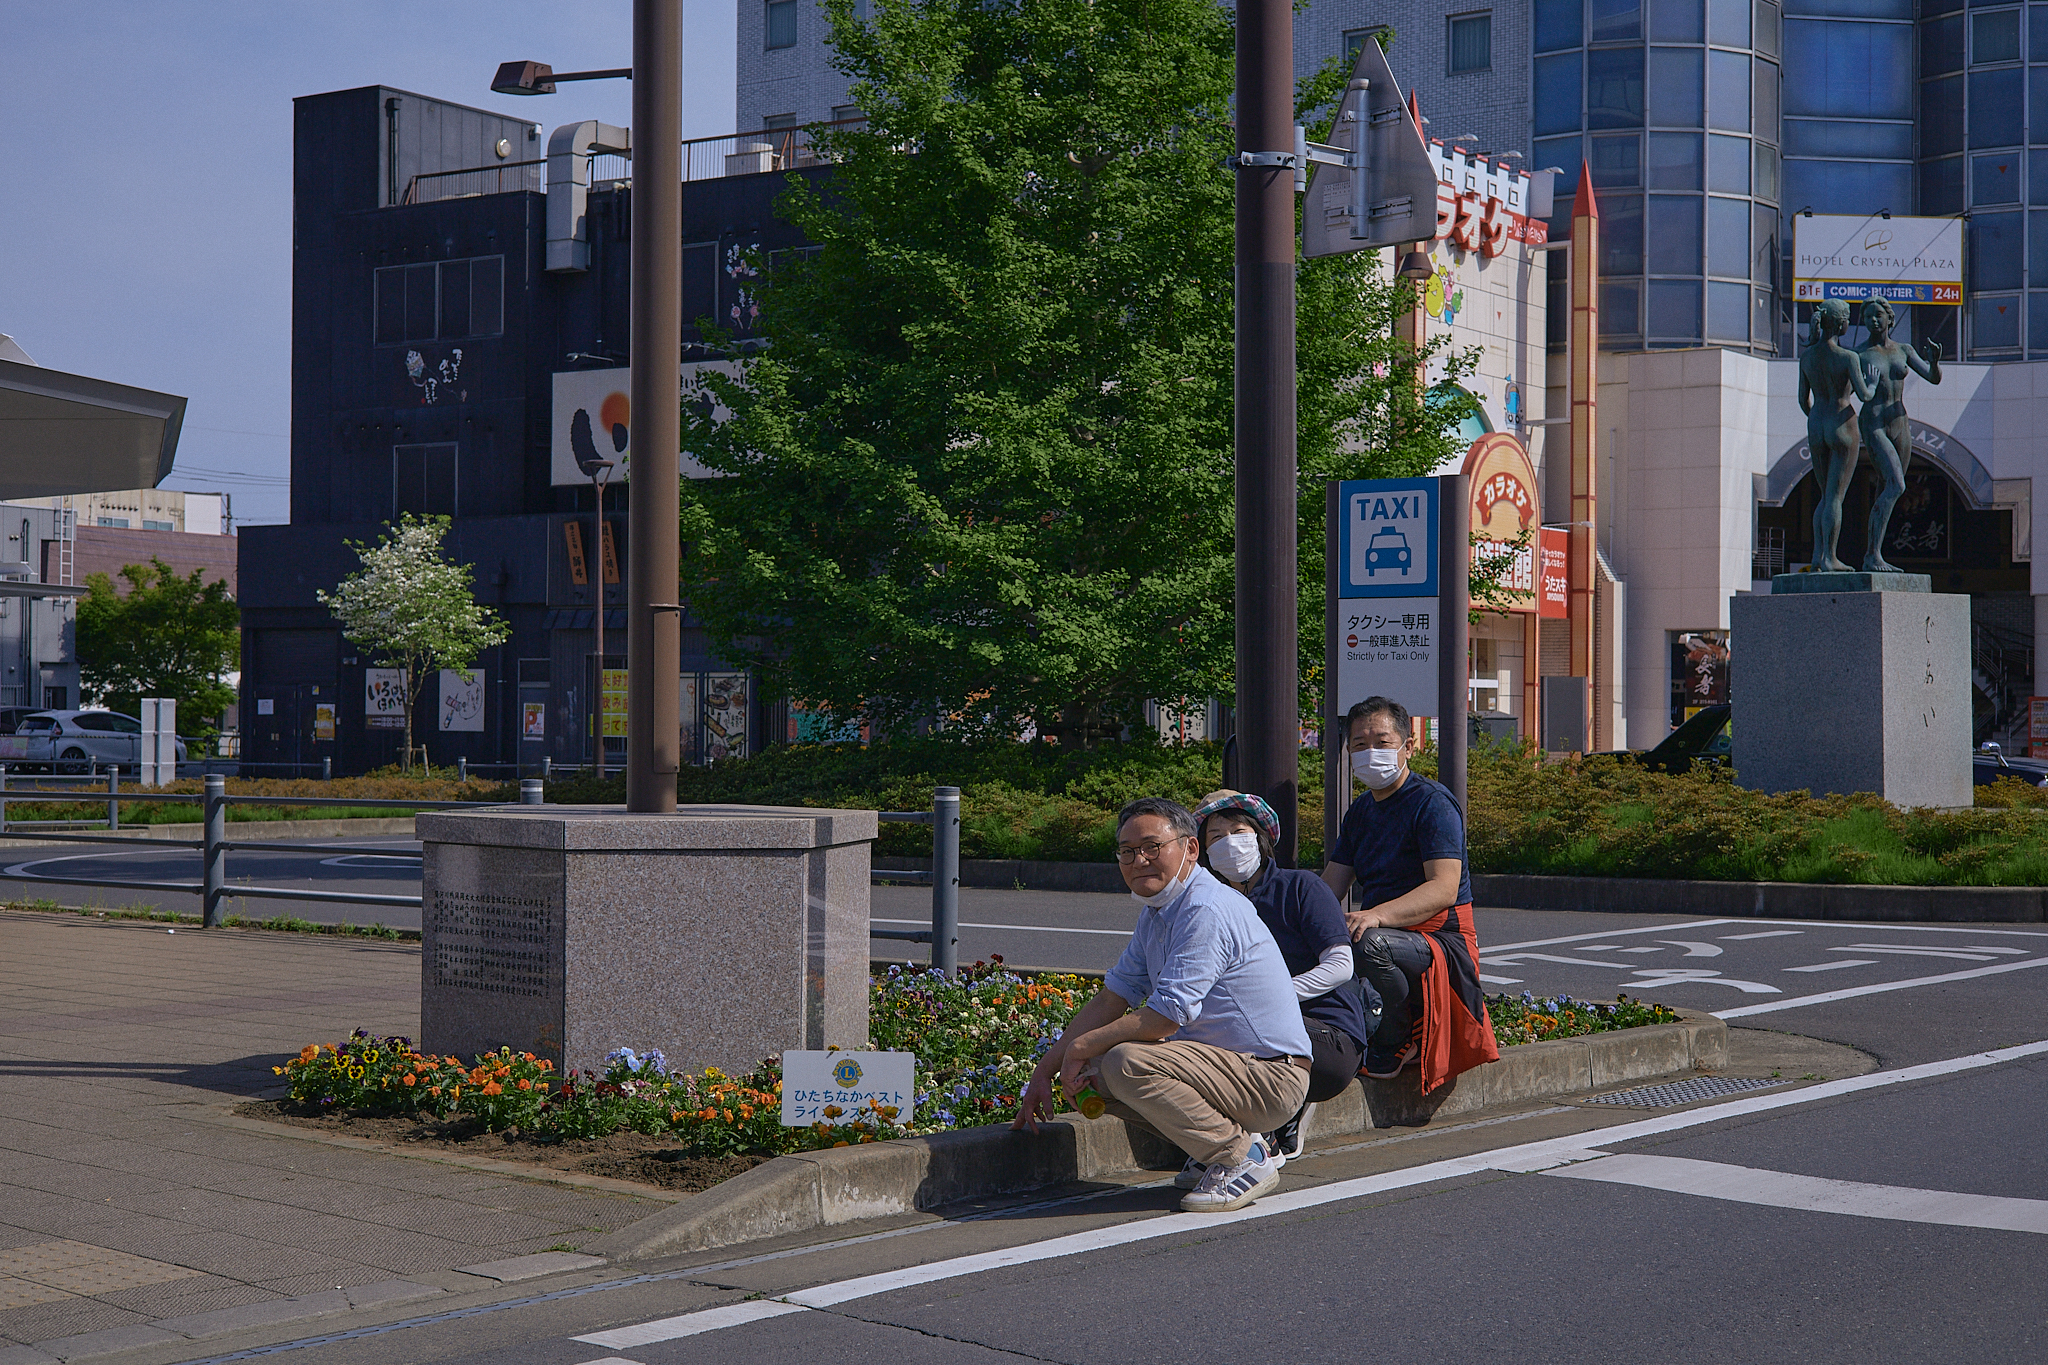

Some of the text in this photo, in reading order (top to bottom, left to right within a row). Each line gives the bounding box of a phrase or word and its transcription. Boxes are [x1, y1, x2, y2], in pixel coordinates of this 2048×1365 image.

[1801, 254, 1955, 269] HOTEL CRYSTAL PLAZA
[1799, 284, 1821, 297] B1F
[1934, 287, 1960, 300] 24H
[1483, 475, 1528, 508] カラオケ
[1356, 496, 1420, 521] TAXI
[1545, 575, 1566, 593] うたスキ
[1347, 613, 1430, 631] タクシー専用
[1359, 635, 1430, 648] 一般車進入禁止
[1347, 650, 1430, 663] Strictly for Taxi Only
[794, 1089, 904, 1104] ひたちなかベスト
